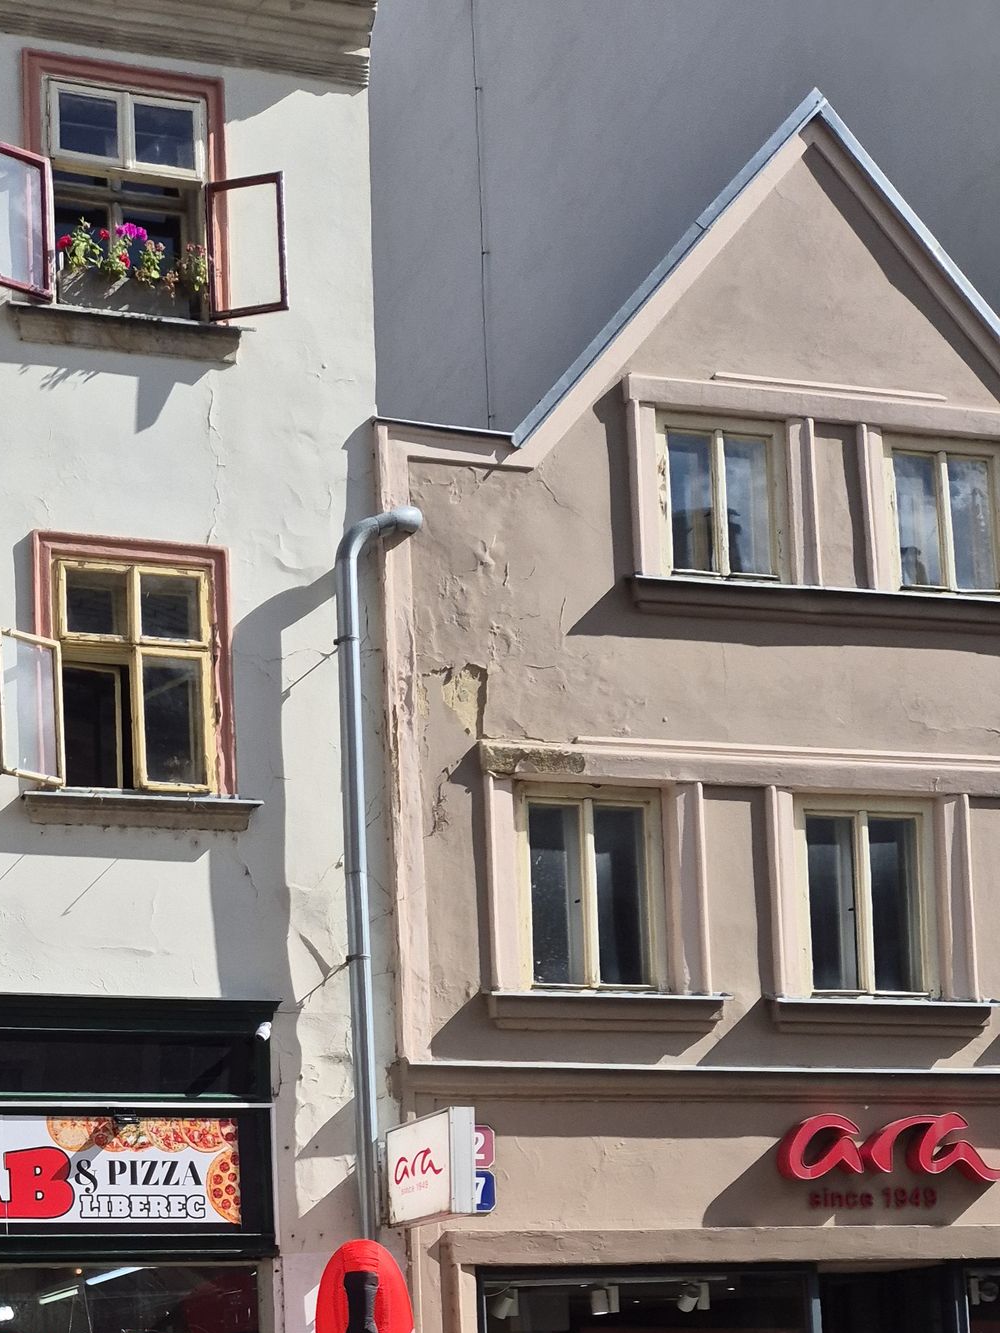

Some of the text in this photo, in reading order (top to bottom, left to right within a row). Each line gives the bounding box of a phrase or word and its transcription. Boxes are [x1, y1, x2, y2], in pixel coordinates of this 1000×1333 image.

[784, 1112, 1000, 1181] ara
[75, 1159, 203, 1194] & PIZZA
[394, 1147, 443, 1185] ara
[79, 1194, 206, 1219] LIBEREC
[808, 1186, 938, 1210] since 1949
